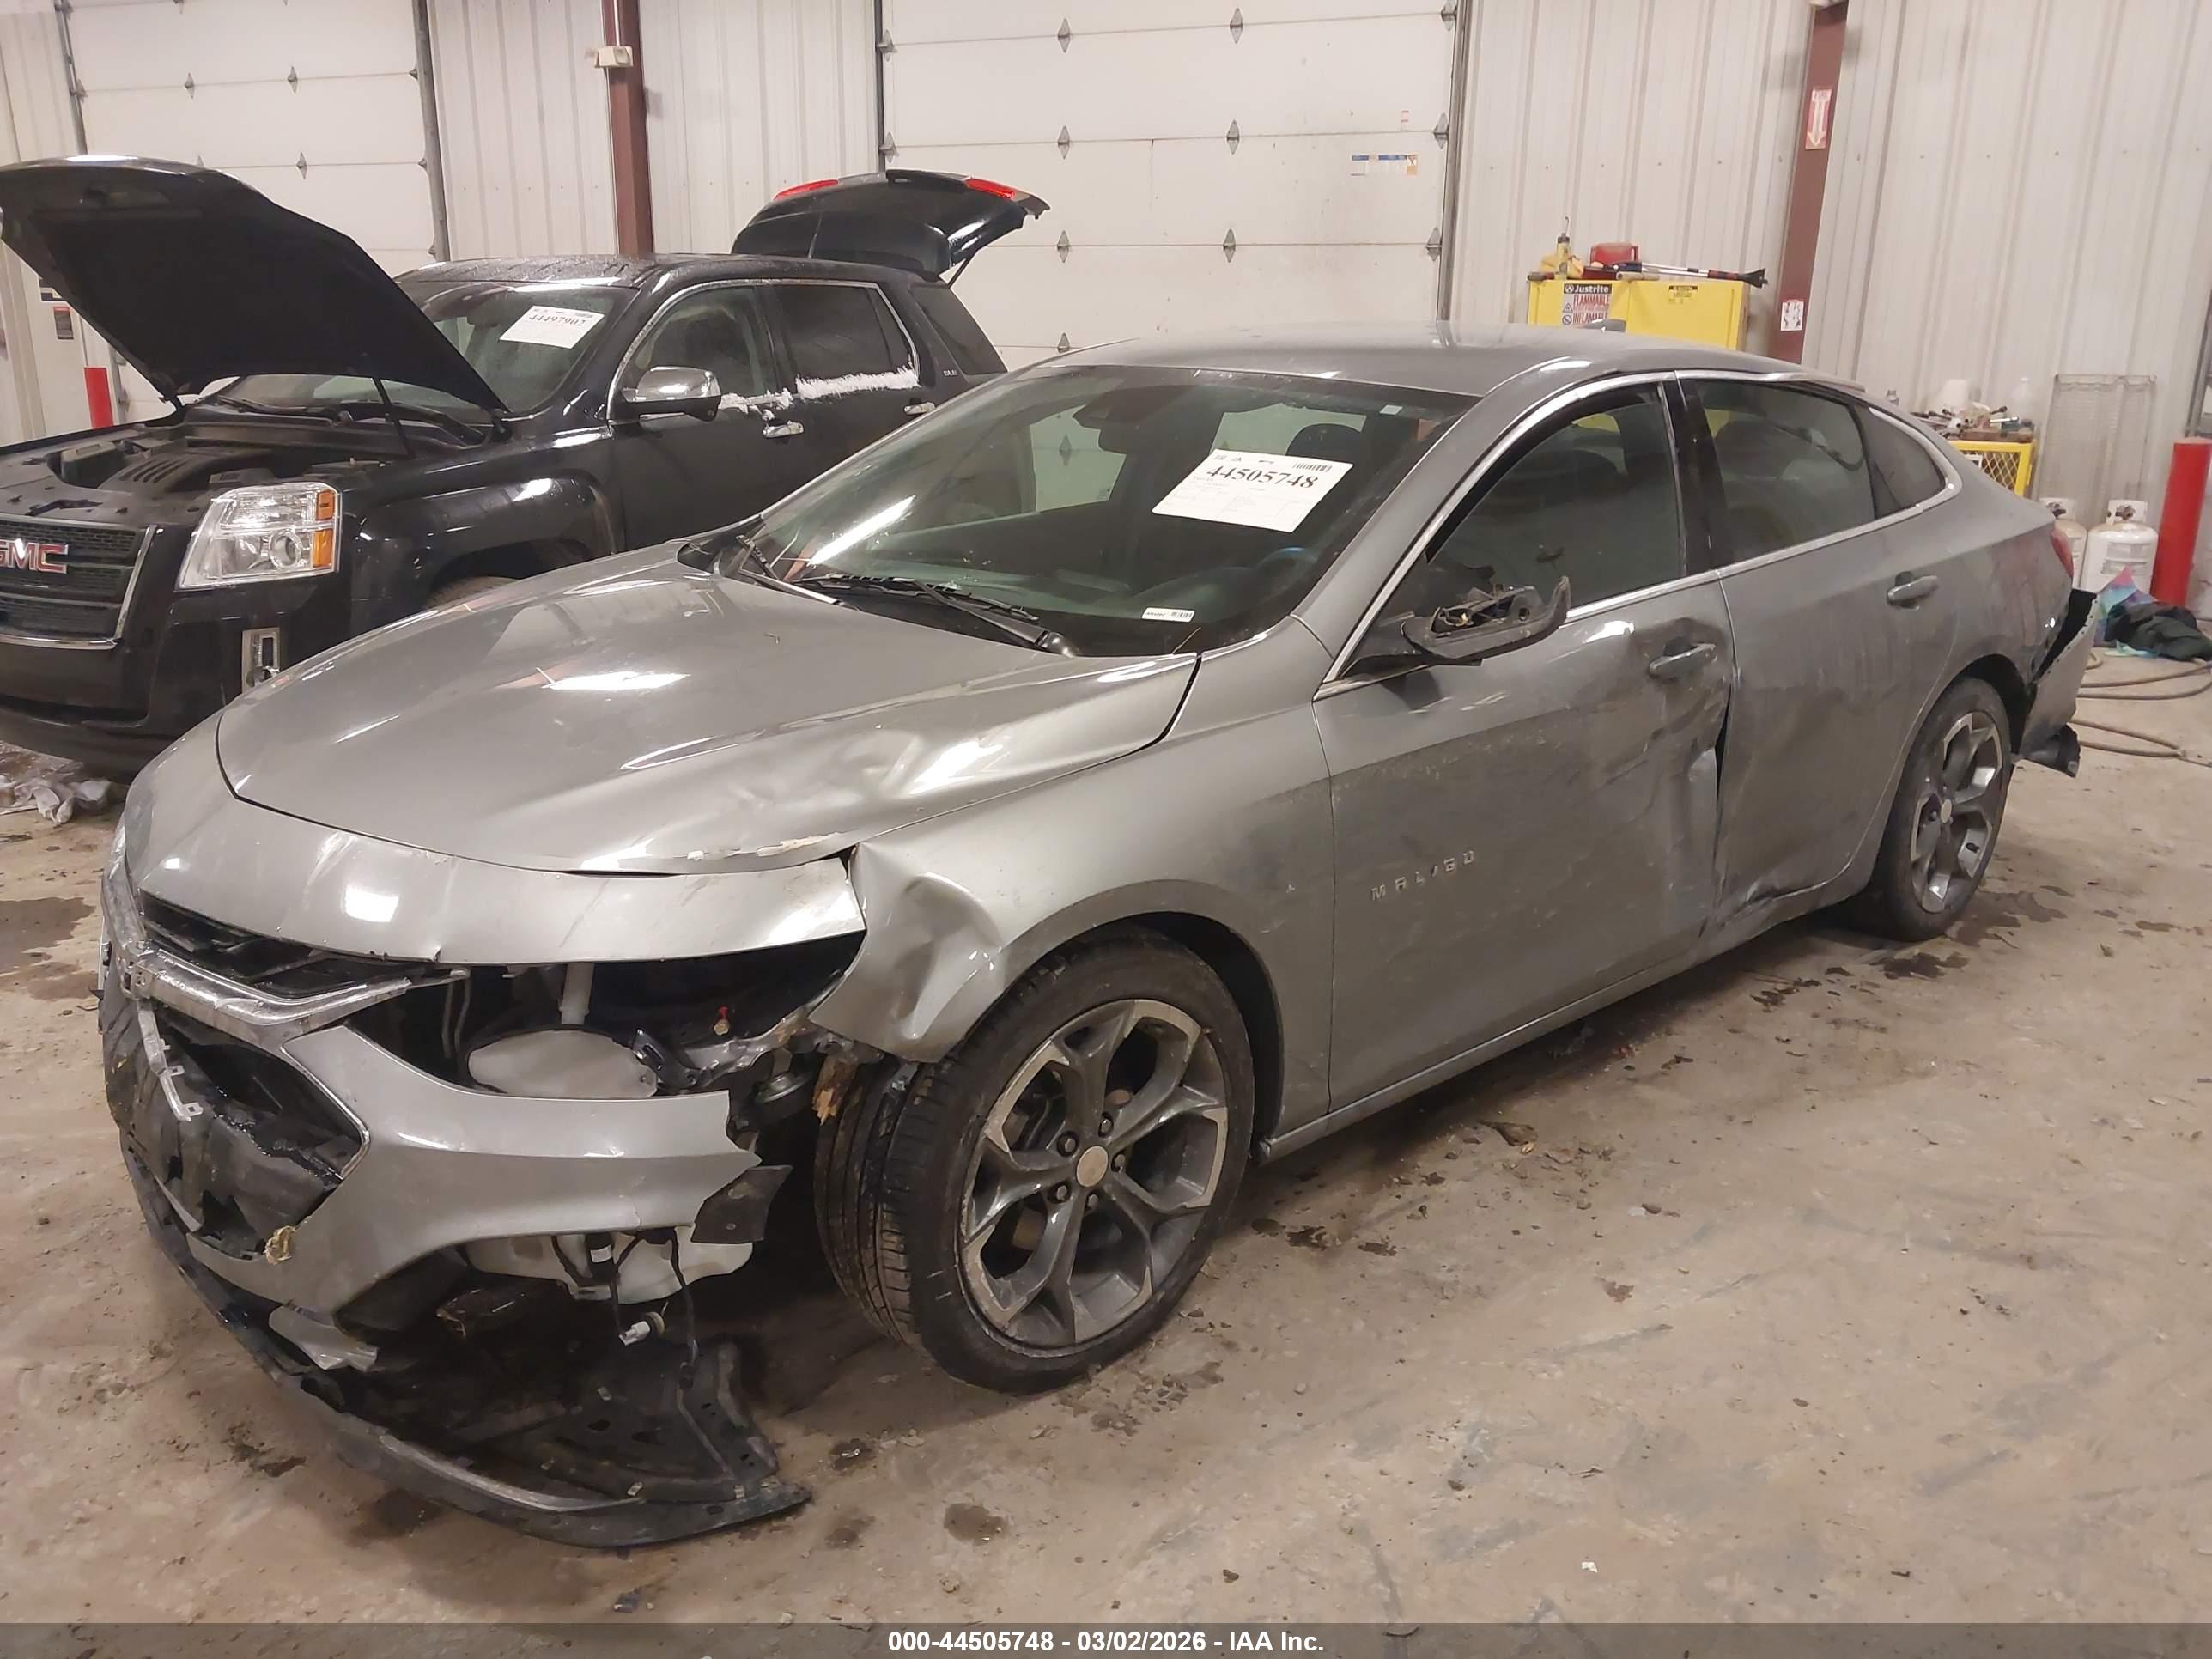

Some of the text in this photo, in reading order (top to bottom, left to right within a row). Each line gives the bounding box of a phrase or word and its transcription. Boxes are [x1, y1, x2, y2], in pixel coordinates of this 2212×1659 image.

[1574, 284, 1609, 293] Justrite
[1573, 295, 1609, 307] FLAMMABLE
[1206, 465, 1319, 489] 44505748
[1370, 850, 1474, 901] MALIBU
